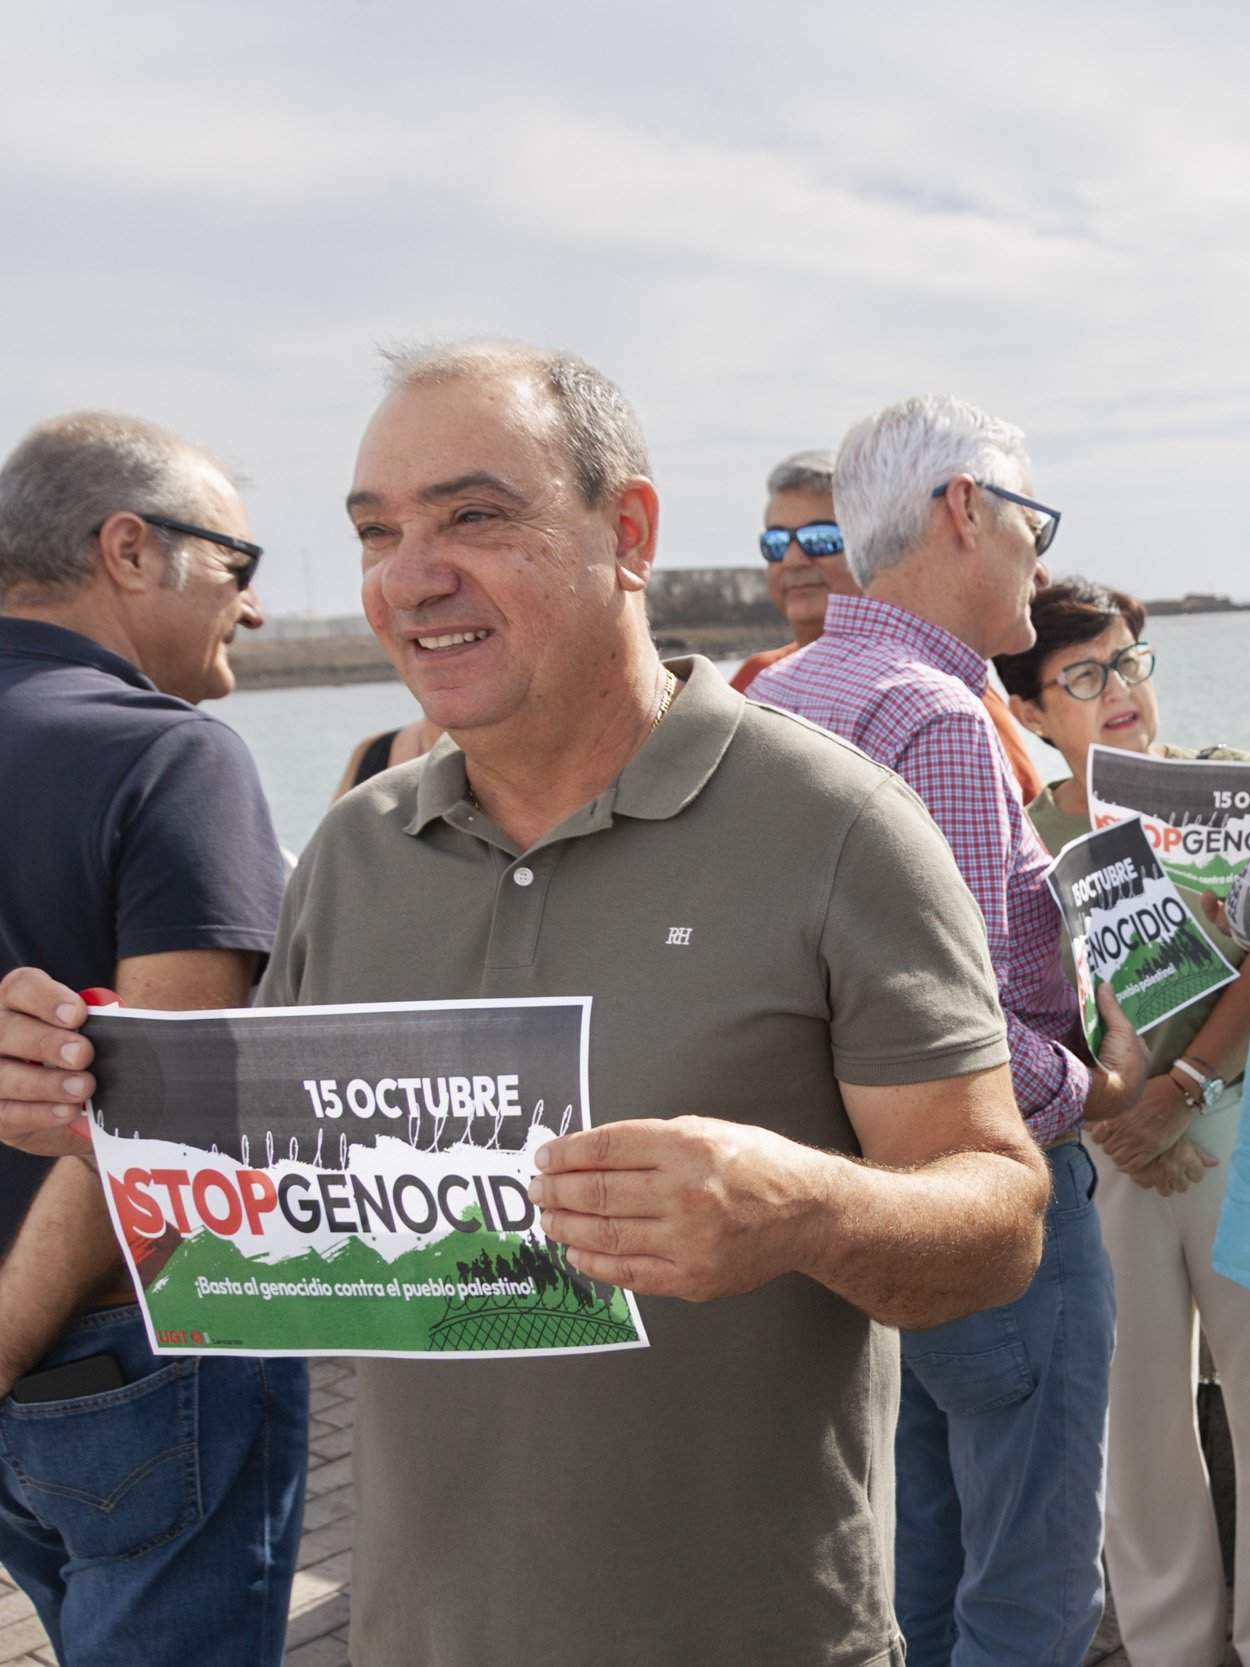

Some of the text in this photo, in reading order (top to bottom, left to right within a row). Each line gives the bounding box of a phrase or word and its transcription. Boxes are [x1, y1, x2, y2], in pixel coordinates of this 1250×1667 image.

[1213, 791, 1232, 809] 15
[1078, 857, 1138, 902] OCTUBRE
[304, 1075, 522, 1119] 15 OCTUBRE
[123, 1167, 537, 1236] STOPGENOCID
[195, 1275, 536, 1301] ¡Basta al genocidio contra el pueblo palestino!
